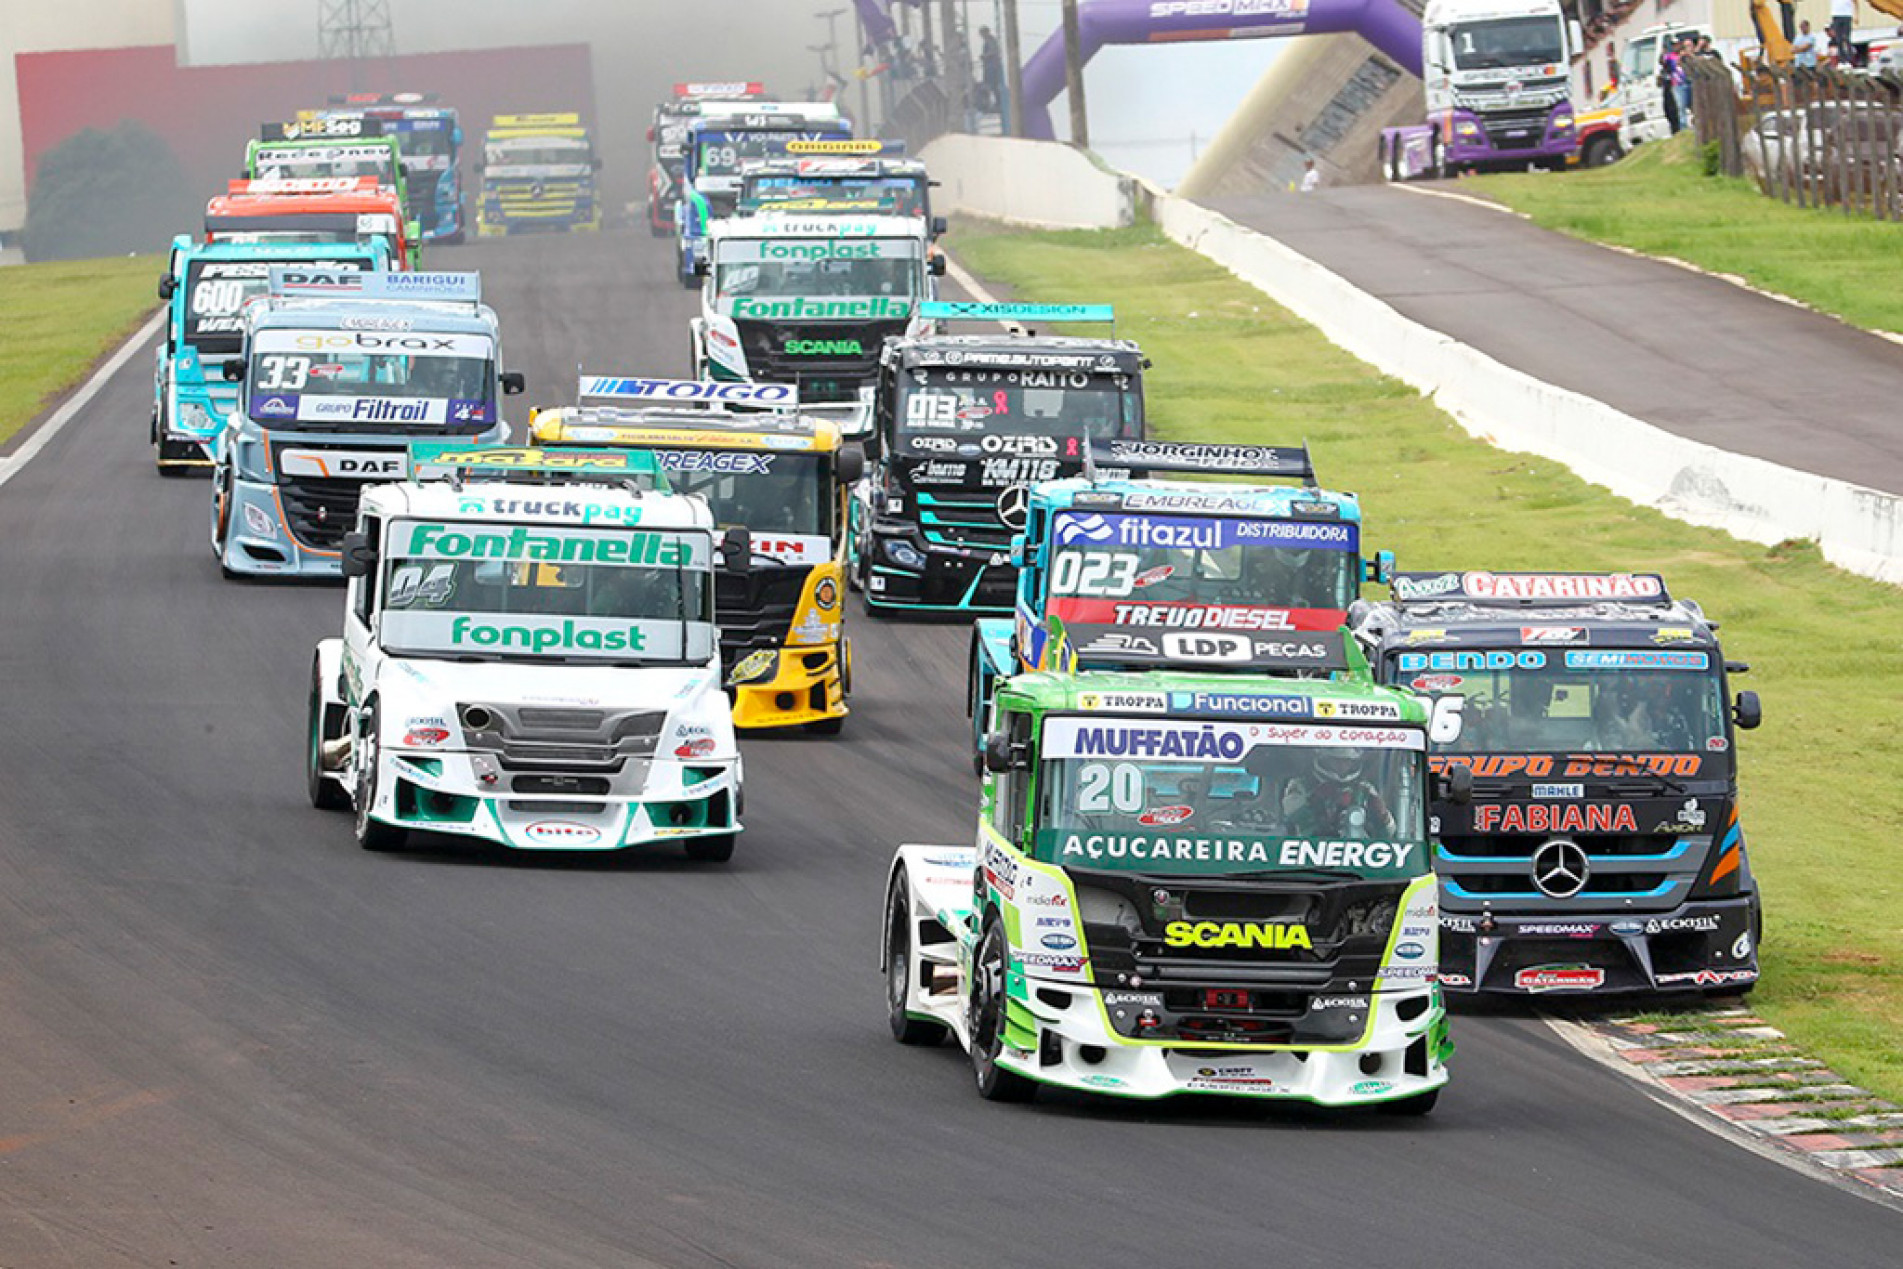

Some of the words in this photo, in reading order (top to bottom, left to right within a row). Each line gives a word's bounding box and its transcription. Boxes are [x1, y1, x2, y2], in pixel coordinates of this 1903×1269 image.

[705, 147, 738, 167] 69
[760, 239, 882, 261] fonplast
[283, 275, 363, 285] DAF
[387, 274, 467, 285] BARIGUI
[193, 281, 243, 315] 600
[731, 297, 909, 320] Fontanella
[296, 333, 457, 351] gobrax
[784, 340, 864, 355] SCANIA
[258, 355, 311, 389] 33
[1020, 370, 1088, 389] RAITO
[638, 381, 790, 400] TOIGO
[352, 399, 429, 421] Filtroil
[1131, 443, 1262, 459] JORGINHO
[339, 459, 400, 473] DAF
[493, 498, 642, 527] truckpag
[1118, 517, 1223, 548] fitazul
[1236, 521, 1349, 542] DISTRIBUIDORA
[408, 525, 693, 566] Fontanella
[389, 562, 461, 607] 04
[1051, 552, 1139, 597] 023
[1464, 571, 1662, 597] CATARINÃO
[452, 616, 648, 653] fonplast
[1178, 637, 1238, 658] LDP
[1254, 642, 1327, 659] PEÇAS
[1399, 652, 1546, 670] BENDO
[1103, 695, 1164, 709] TROPPA
[1193, 694, 1309, 714] Funcional
[1339, 702, 1399, 716] TROPPA
[1074, 724, 1245, 759] MUFFATÃO
[1564, 755, 1702, 776] BENDO
[1079, 764, 1143, 813] 20
[1534, 785, 1580, 797] MAHLE
[1484, 805, 1637, 832] FABIANA
[1062, 836, 1269, 866] AÇUCAREIRA
[1279, 841, 1414, 869] ENERGY
[1164, 921, 1313, 949] SCANIA
